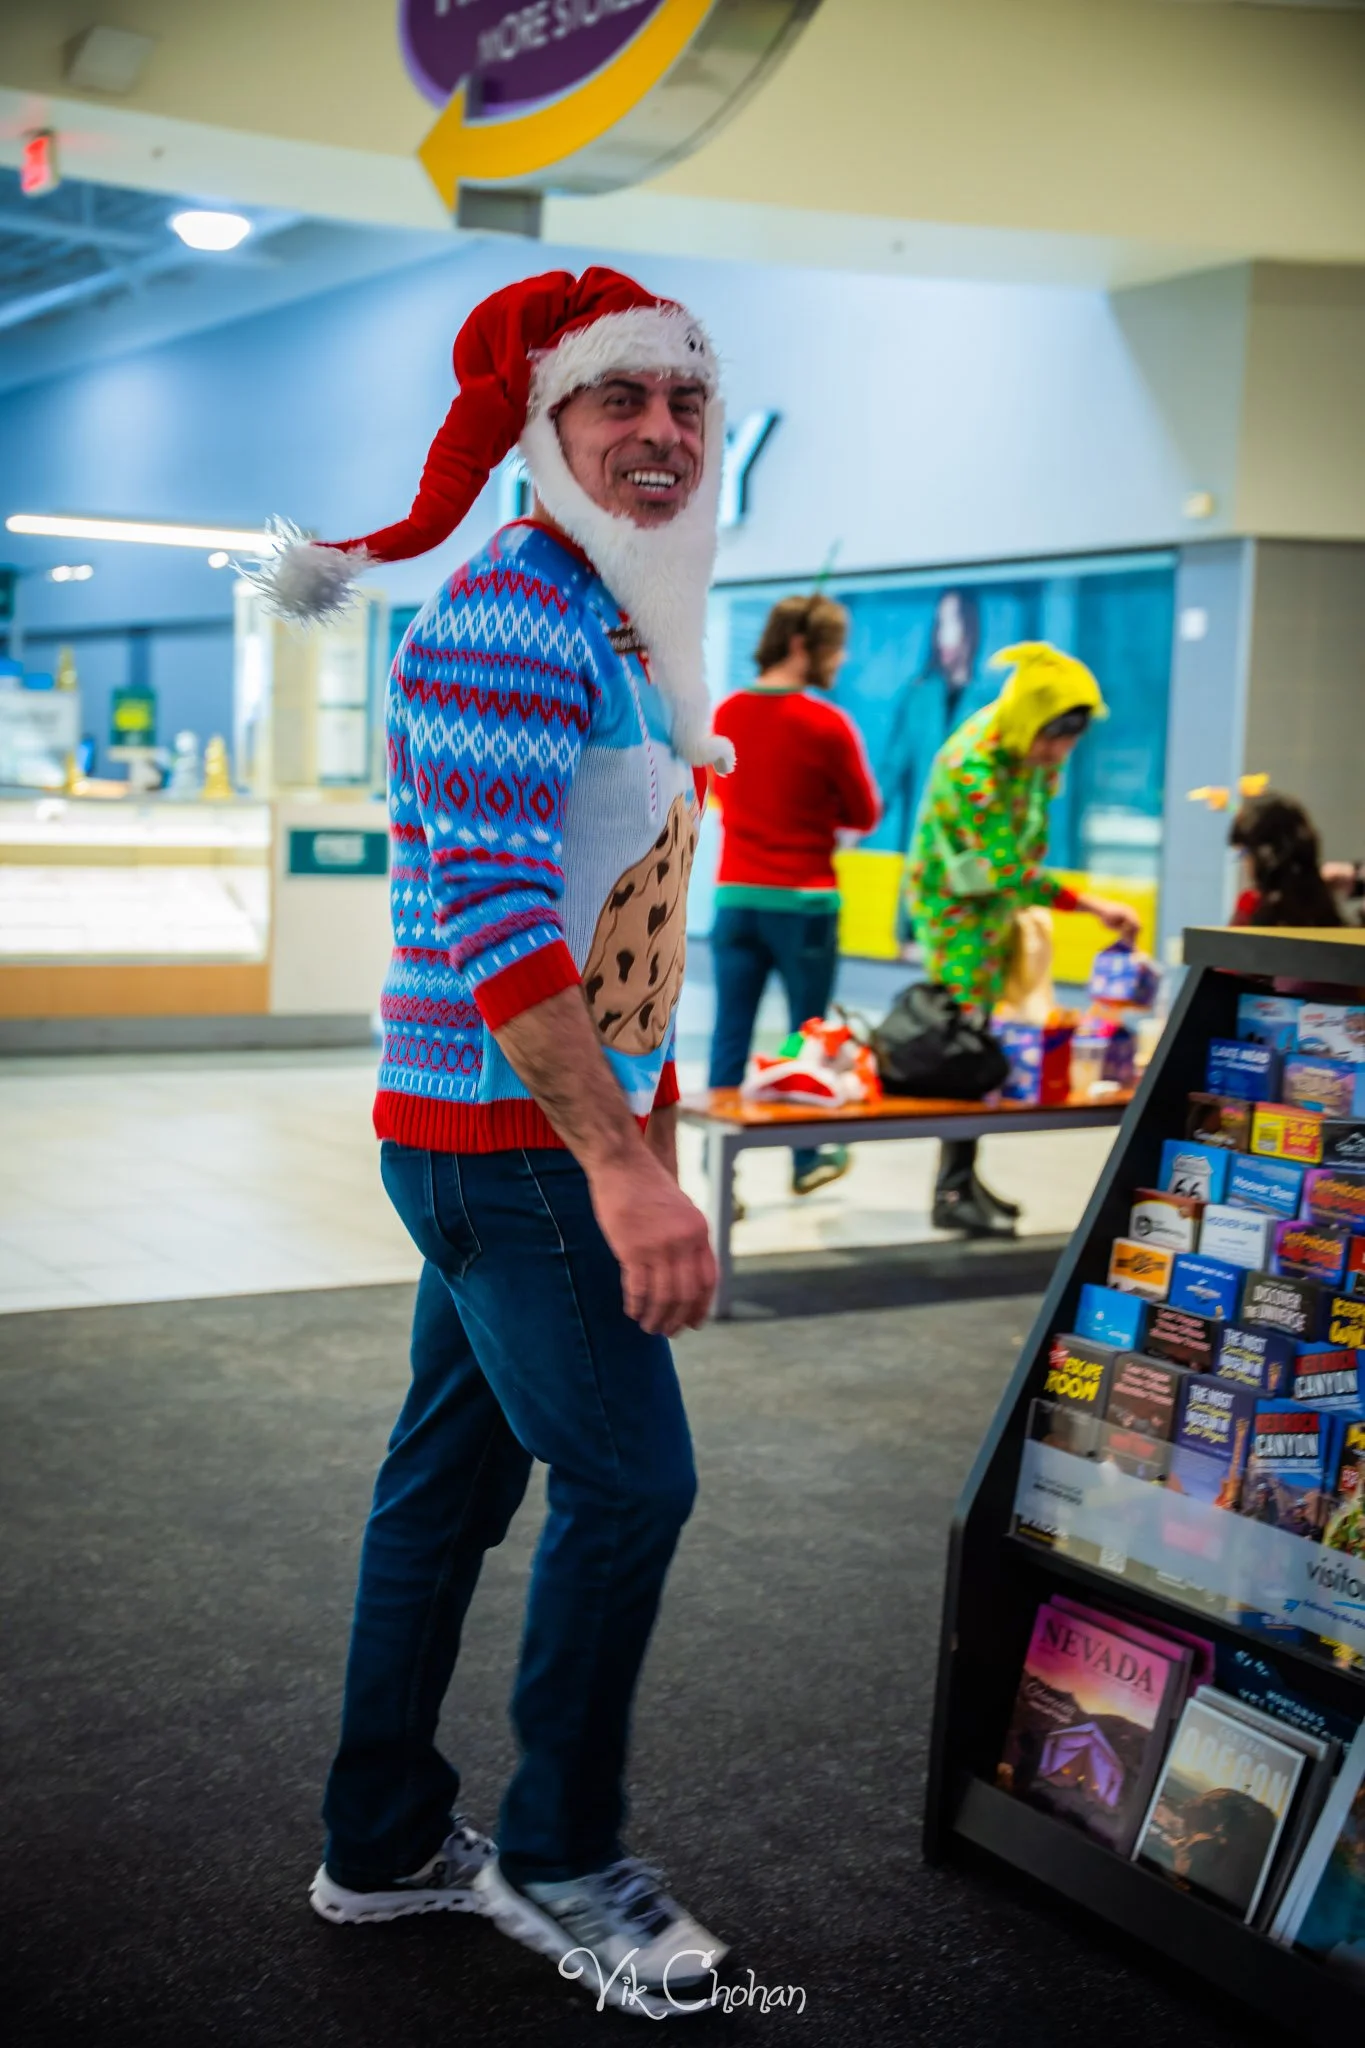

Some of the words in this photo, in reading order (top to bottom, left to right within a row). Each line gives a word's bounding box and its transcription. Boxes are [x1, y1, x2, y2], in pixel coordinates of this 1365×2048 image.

[476, 0, 549, 62] MORE
[1044, 1370, 1100, 1402] ROOM
[1189, 1384, 1209, 1401] THE
[1208, 1388, 1235, 1410] MOST
[1294, 1371, 1358, 1399] CANYON
[1254, 1433, 1319, 1457] CANYON
[1036, 1617, 1156, 1696] NEVADA
[1176, 1726, 1290, 1815] OREGON
